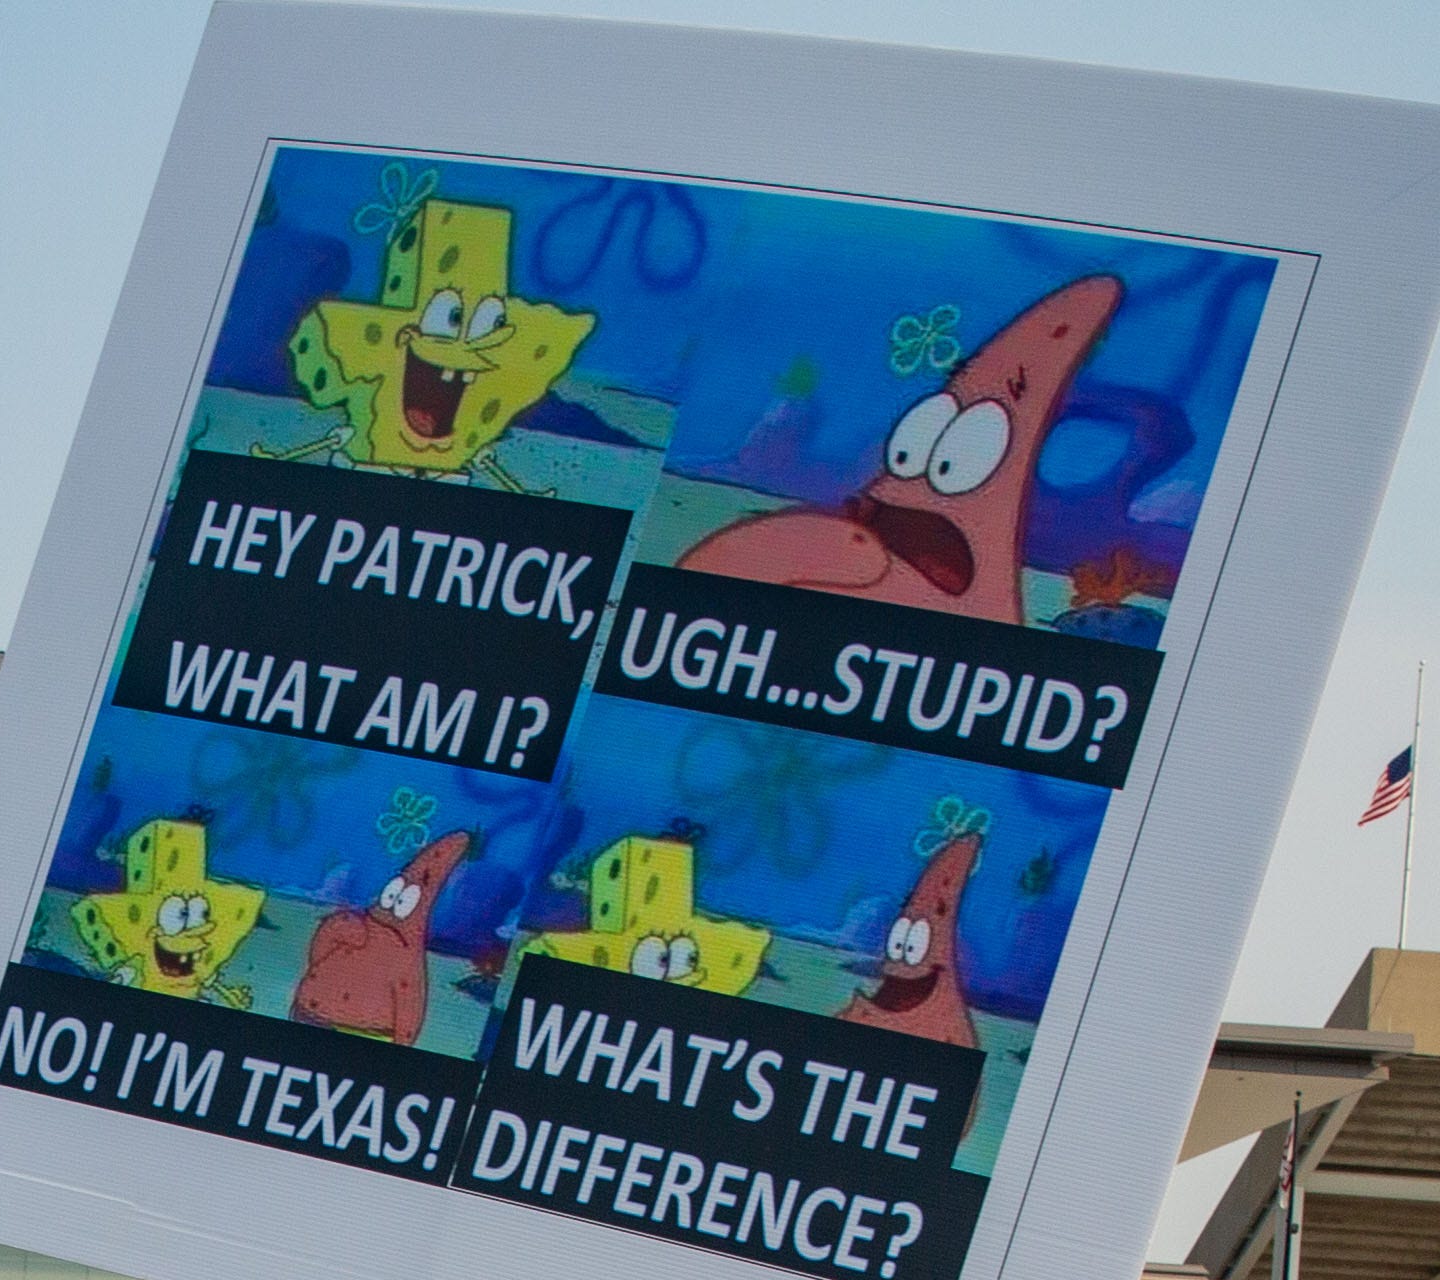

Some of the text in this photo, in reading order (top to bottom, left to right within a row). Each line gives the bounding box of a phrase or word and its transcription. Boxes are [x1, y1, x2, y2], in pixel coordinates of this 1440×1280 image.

[189, 502, 598, 641] HEY PATRICK,
[165, 642, 552, 770] WHAT AM I?
[617, 605, 1130, 763] UGH...STUPID?
[115, 1032, 218, 1119] I'M
[236, 1057, 458, 1170] TEXAS!
[513, 997, 938, 1161] WHAT'S THE
